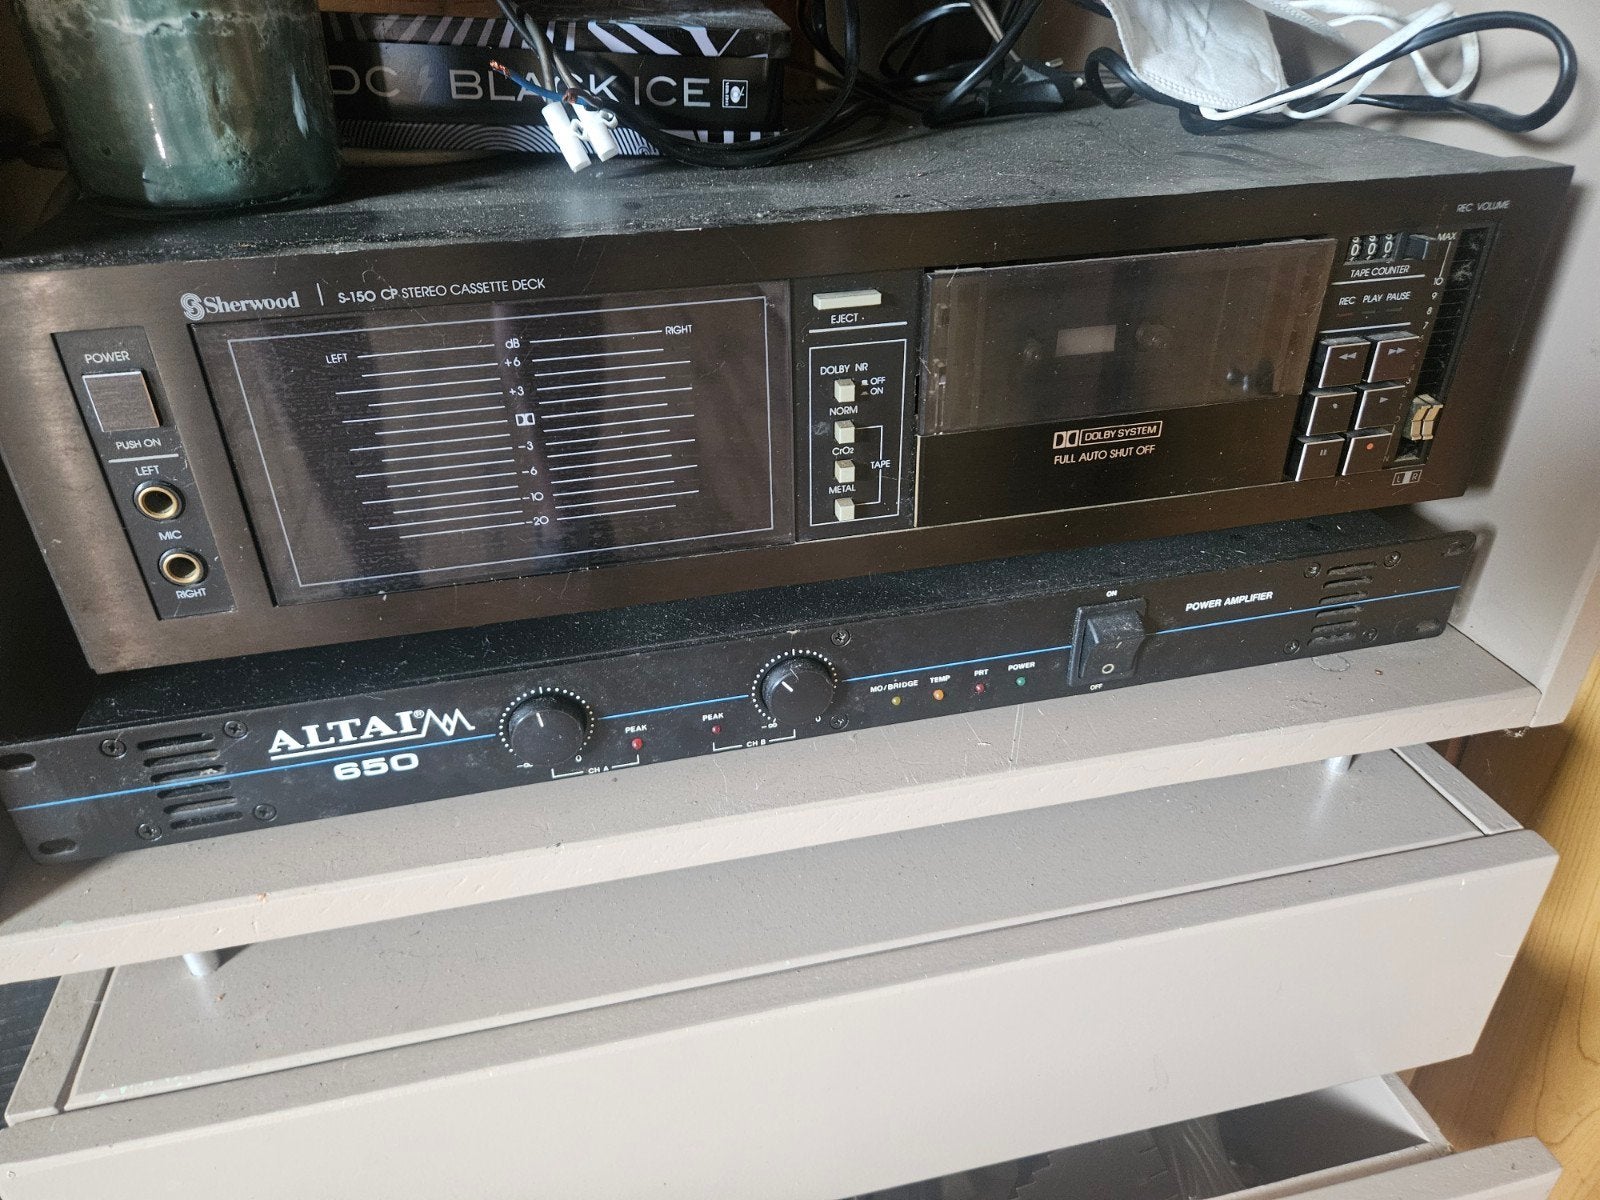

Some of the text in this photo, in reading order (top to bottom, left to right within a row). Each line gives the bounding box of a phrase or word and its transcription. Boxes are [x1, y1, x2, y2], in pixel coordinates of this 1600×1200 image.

[633, 75, 711, 108] ICE
[1456, 200, 1511, 212] REC VOLUME
[1437, 232, 1457, 241] MAX
[1350, 264, 1410, 278] TAPE COUNTER
[1433, 276, 1444, 286] 10
[338, 277, 546, 304] S-150 CP STEREO CASSETTE DECK
[204, 291, 300, 314] Sherwood
[1338, 291, 1412, 306] REC PLAY PAUSE
[830, 312, 859, 324] EJECT
[665, 324, 693, 335] RIGHT
[505, 338, 521, 349] dB
[84, 350, 131, 364] POWER
[326, 352, 348, 365] LEFT
[504, 356, 521, 367] +6
[820, 362, 869, 375] DOLBY NR
[870, 376, 886, 385] OFF
[509, 385, 525, 396] +3
[870, 387, 884, 395] ON
[829, 405, 859, 416] NORM
[1084, 425, 1158, 441] DOLBY SYSTEM
[115, 437, 162, 450] PUSH ON
[518, 441, 534, 451] -3
[1053, 444, 1156, 465] FULL AUTO SHUT OFF
[870, 459, 891, 469] TAPE
[135, 464, 160, 476] LEFT
[522, 466, 538, 476] -6
[828, 484, 856, 494] METAL
[525, 515, 550, 526] -20
[158, 530, 183, 541] MIC
[175, 588, 207, 600] RIGHT
[1185, 591, 1274, 612] POWER AMPLIFIER
[1007, 661, 1036, 671] POWER
[974, 668, 989, 677] PRT
[929, 674, 951, 684] TEMP
[870, 679, 919, 693] MO/BRIDGE
[1089, 683, 1103, 691] OFF
[702, 712, 724, 721] PEAK
[624, 724, 648, 734] PEAK
[746, 740, 758, 748] CH
[333, 753, 420, 781] 650
